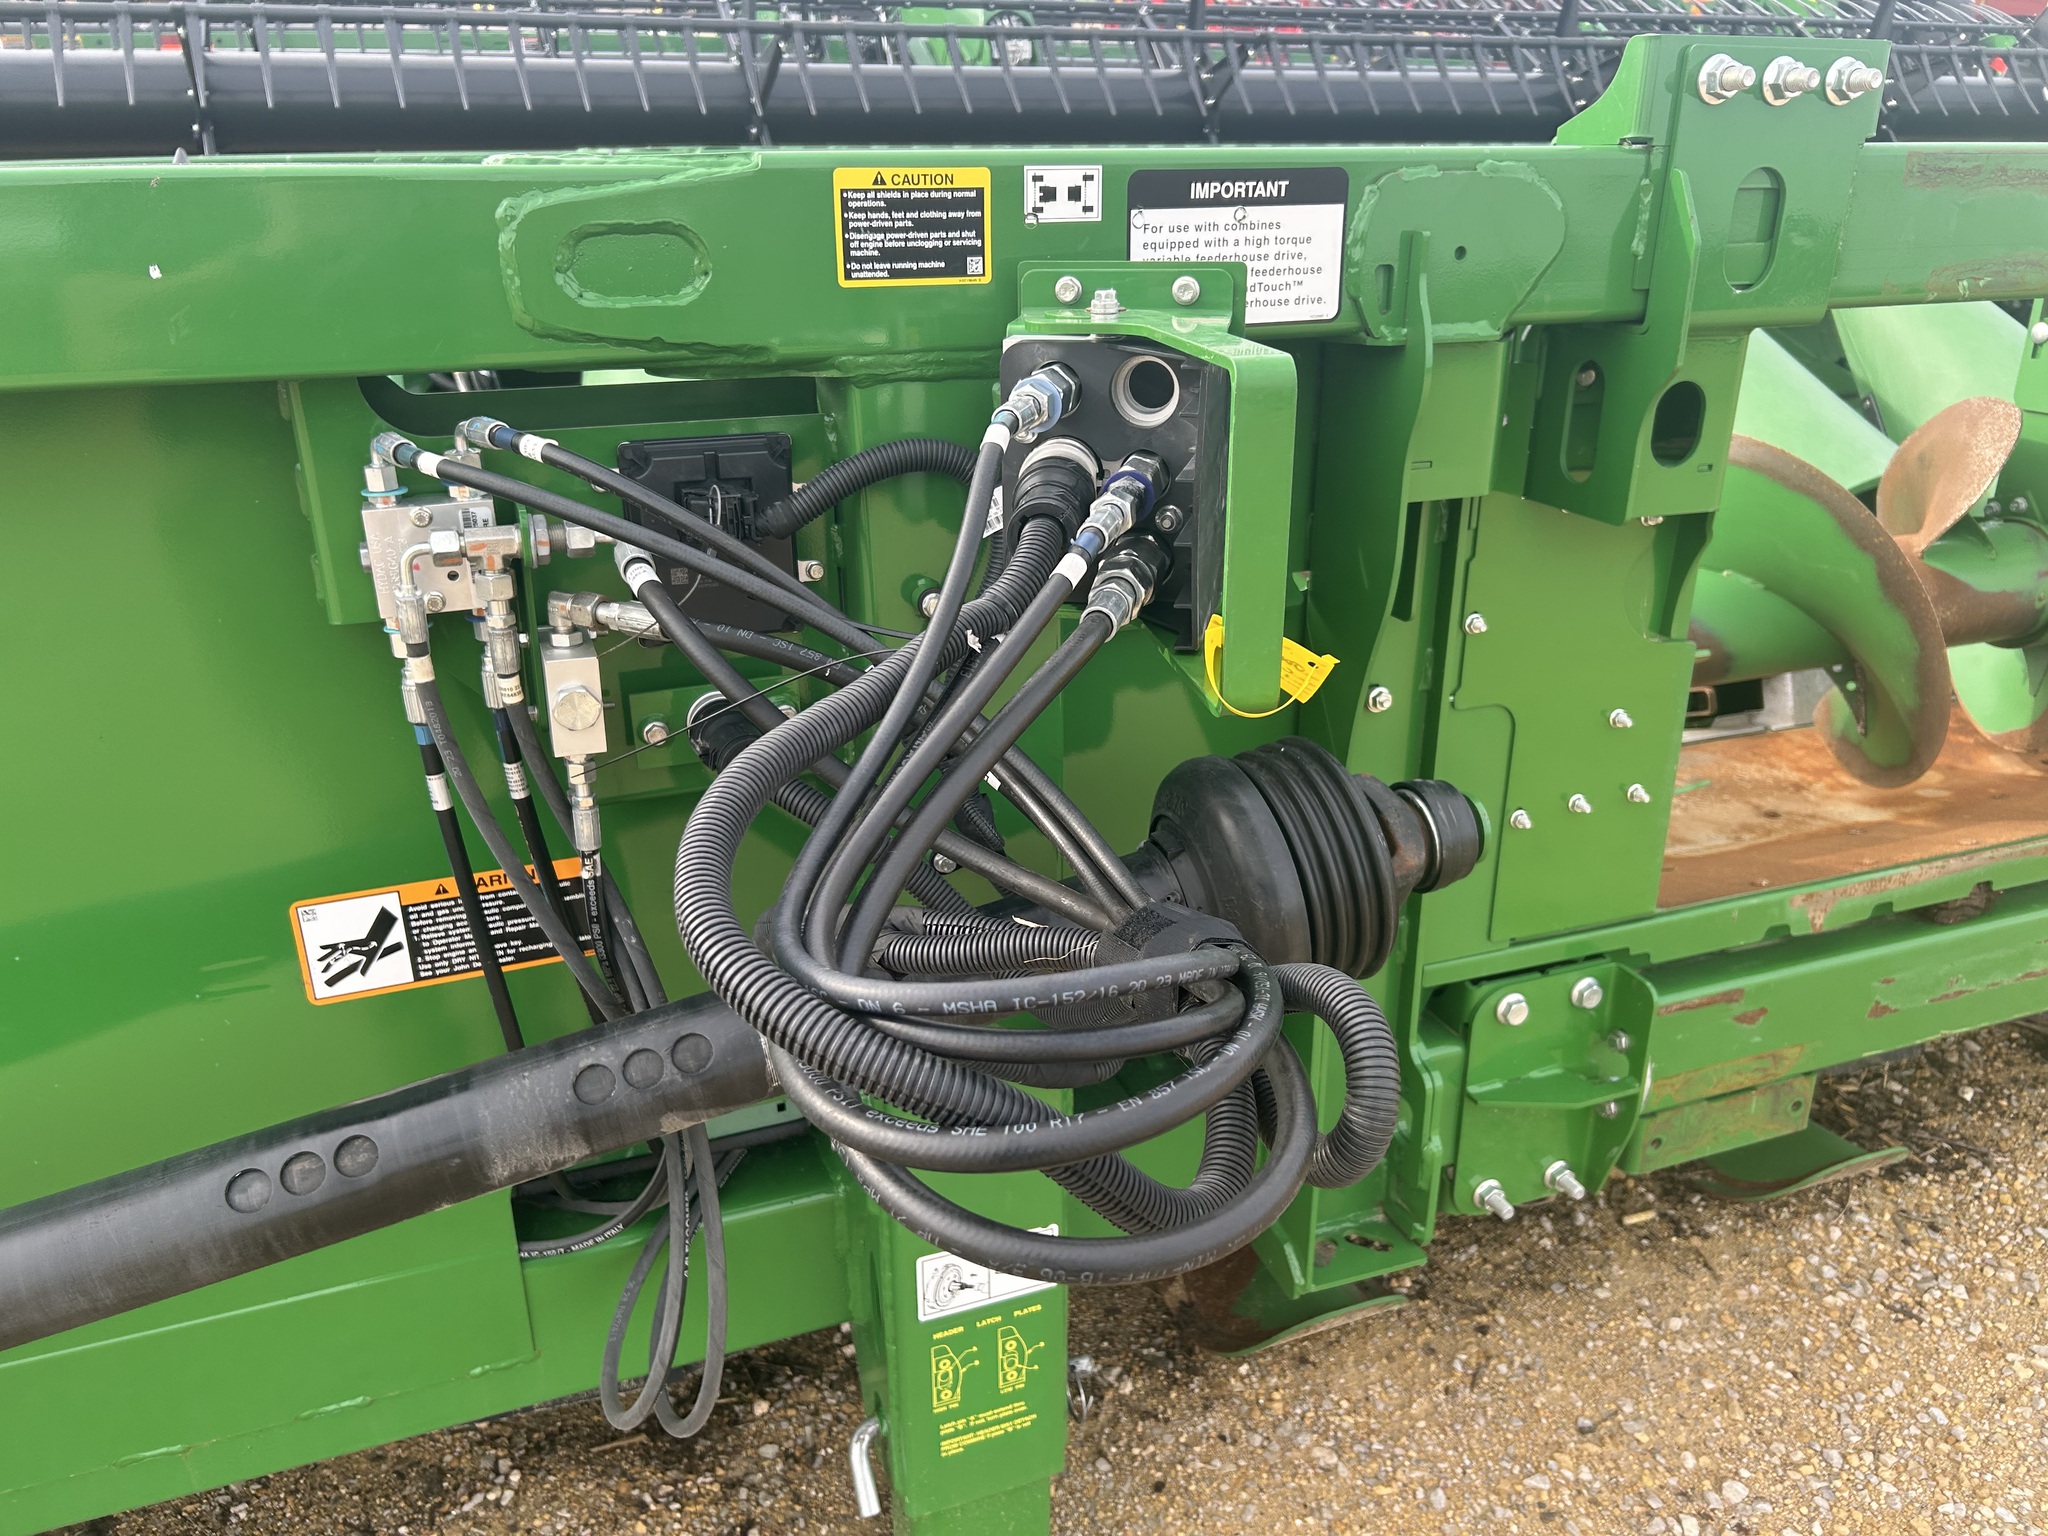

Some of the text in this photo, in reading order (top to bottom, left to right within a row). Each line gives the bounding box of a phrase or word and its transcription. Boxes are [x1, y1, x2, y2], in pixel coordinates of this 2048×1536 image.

[892, 174, 954, 185] CAUTION
[911, 191, 928, 199] place
[930, 190, 952, 199] during
[1191, 181, 1289, 199] IMPORTANT
[920, 211, 946, 219] clothing
[895, 220, 914, 228] parts.
[1143, 220, 1281, 234] For use with combines
[1143, 235, 1312, 252] equipped with a high torque
[1274, 251, 1307, 261] drive,
[892, 262, 917, 270] running
[1251, 265, 1322, 277] feederhouse
[1294, 295, 1326, 306] drive.
[717, 624, 730, 632] 10
[737, 629, 754, 639] DN
[800, 648, 822, 660] 857
[587, 880, 596, 917] exceeds
[857, 998, 882, 1012] DN
[942, 1000, 998, 1014] MSHA
[1012, 984, 1118, 1010] IC-152/16
[1129, 980, 1147, 994] 20
[1156, 975, 1172, 987] 23
[1177, 969, 1204, 984] MADE
[1117, 1096, 1144, 1112] EN
[1148, 1081, 1179, 1100] 857
[570, 1238, 595, 1252] MADE
[596, 1235, 605, 1243] IN
[605, 1223, 624, 1239] ITALY
[932, 1304, 1042, 1341] HEADER LATCH PLATES
